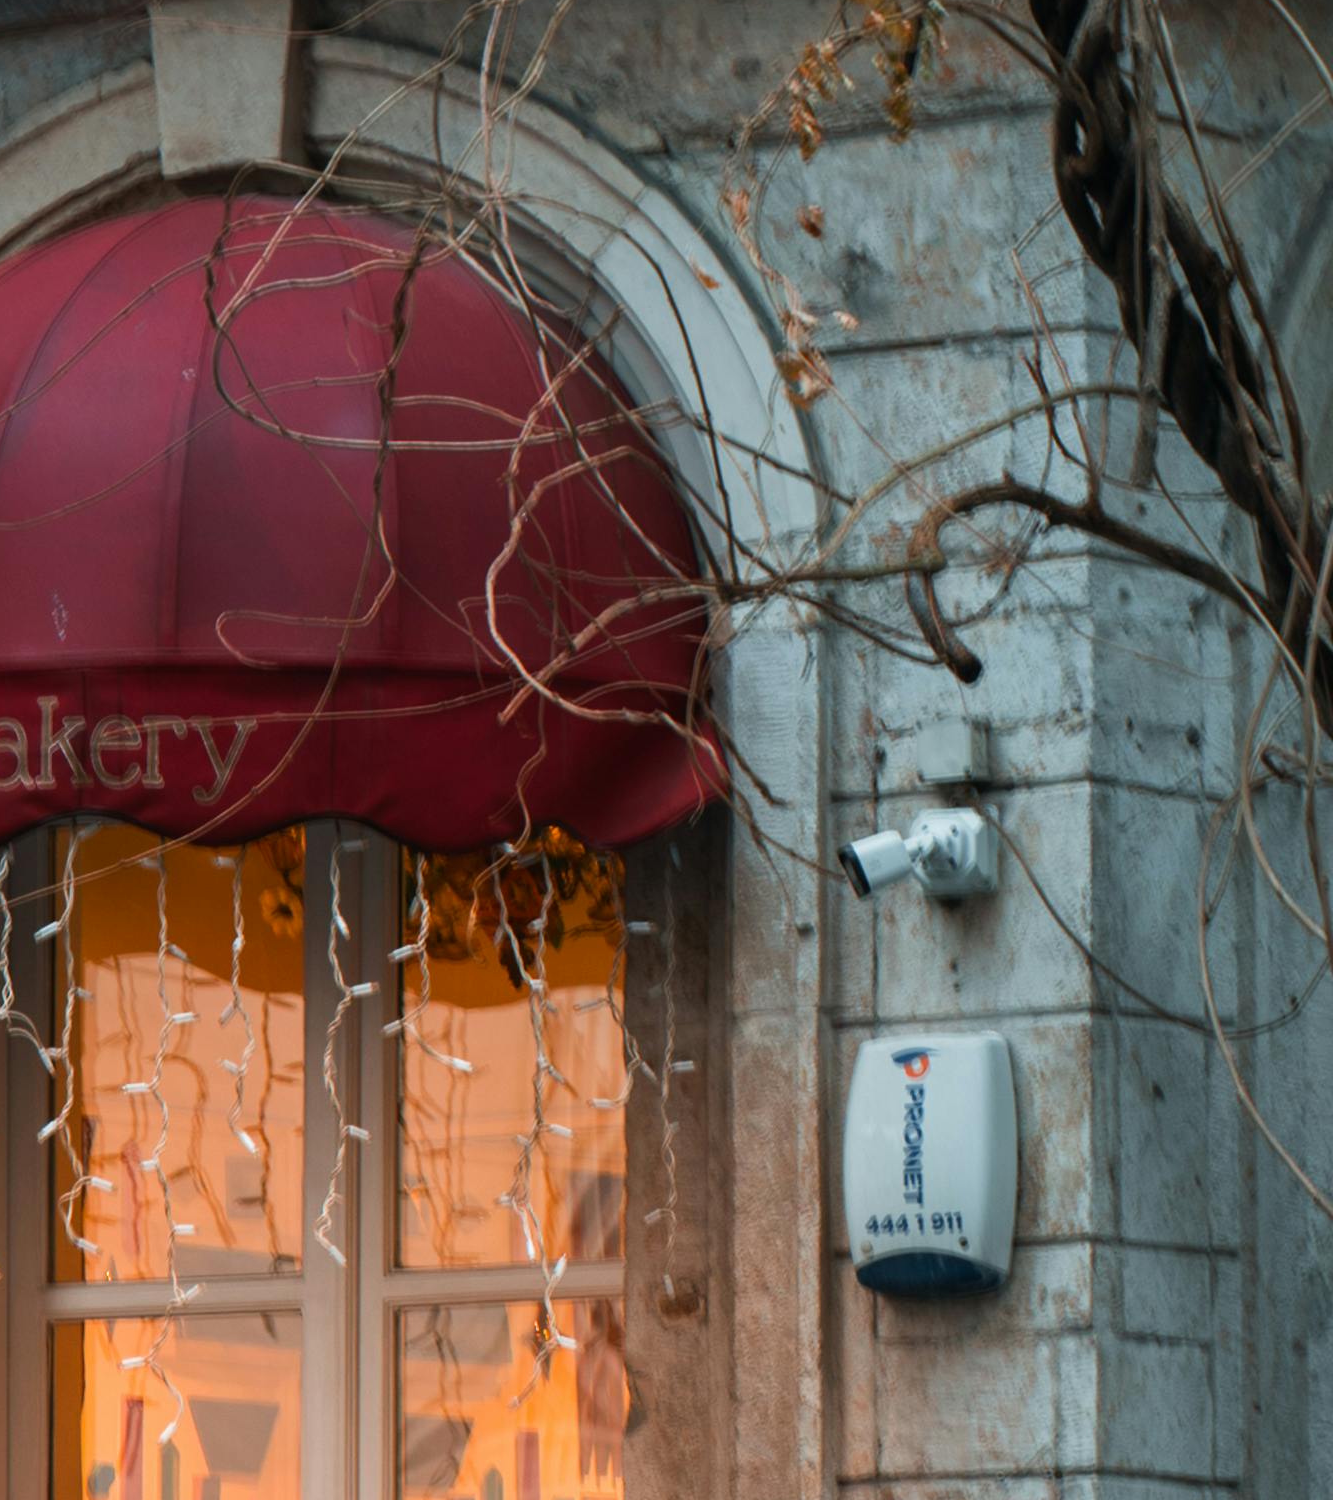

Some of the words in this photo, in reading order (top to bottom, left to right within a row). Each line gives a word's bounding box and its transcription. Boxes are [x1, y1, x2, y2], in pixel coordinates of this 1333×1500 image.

[904, 1084, 925, 1208] PRONET
[865, 1213, 910, 1238] 444
[931, 1211, 963, 1236] 911
